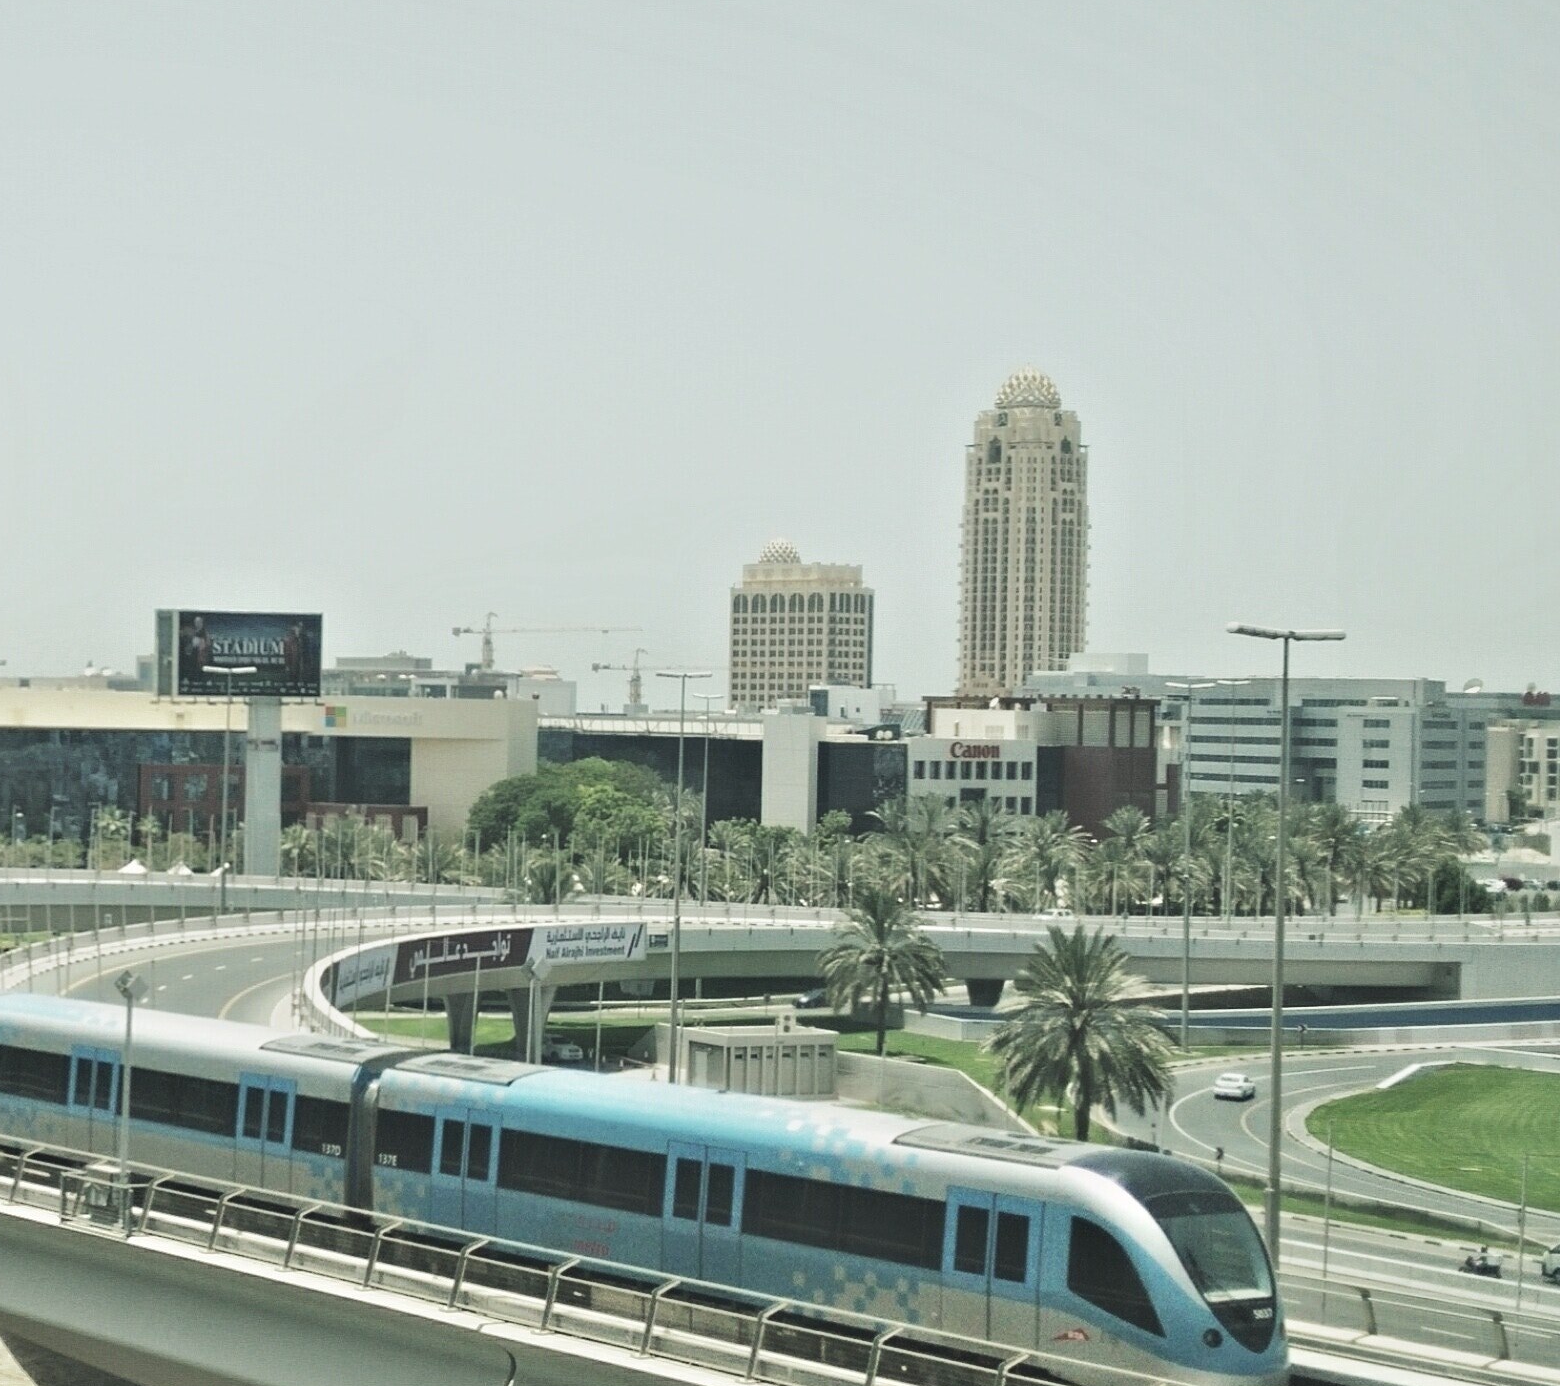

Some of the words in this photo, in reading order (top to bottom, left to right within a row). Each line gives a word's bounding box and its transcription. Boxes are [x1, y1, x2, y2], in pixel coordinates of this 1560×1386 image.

[212, 639, 285, 655] STADIUM
[950, 741, 1000, 758] Canon
[546, 946, 560, 959] Naif
[561, 946, 584, 960] Alrajhi
[585, 945, 625, 956] Investment
[322, 1143, 342, 1156] 137D
[378, 1153, 398, 1166] 137E
